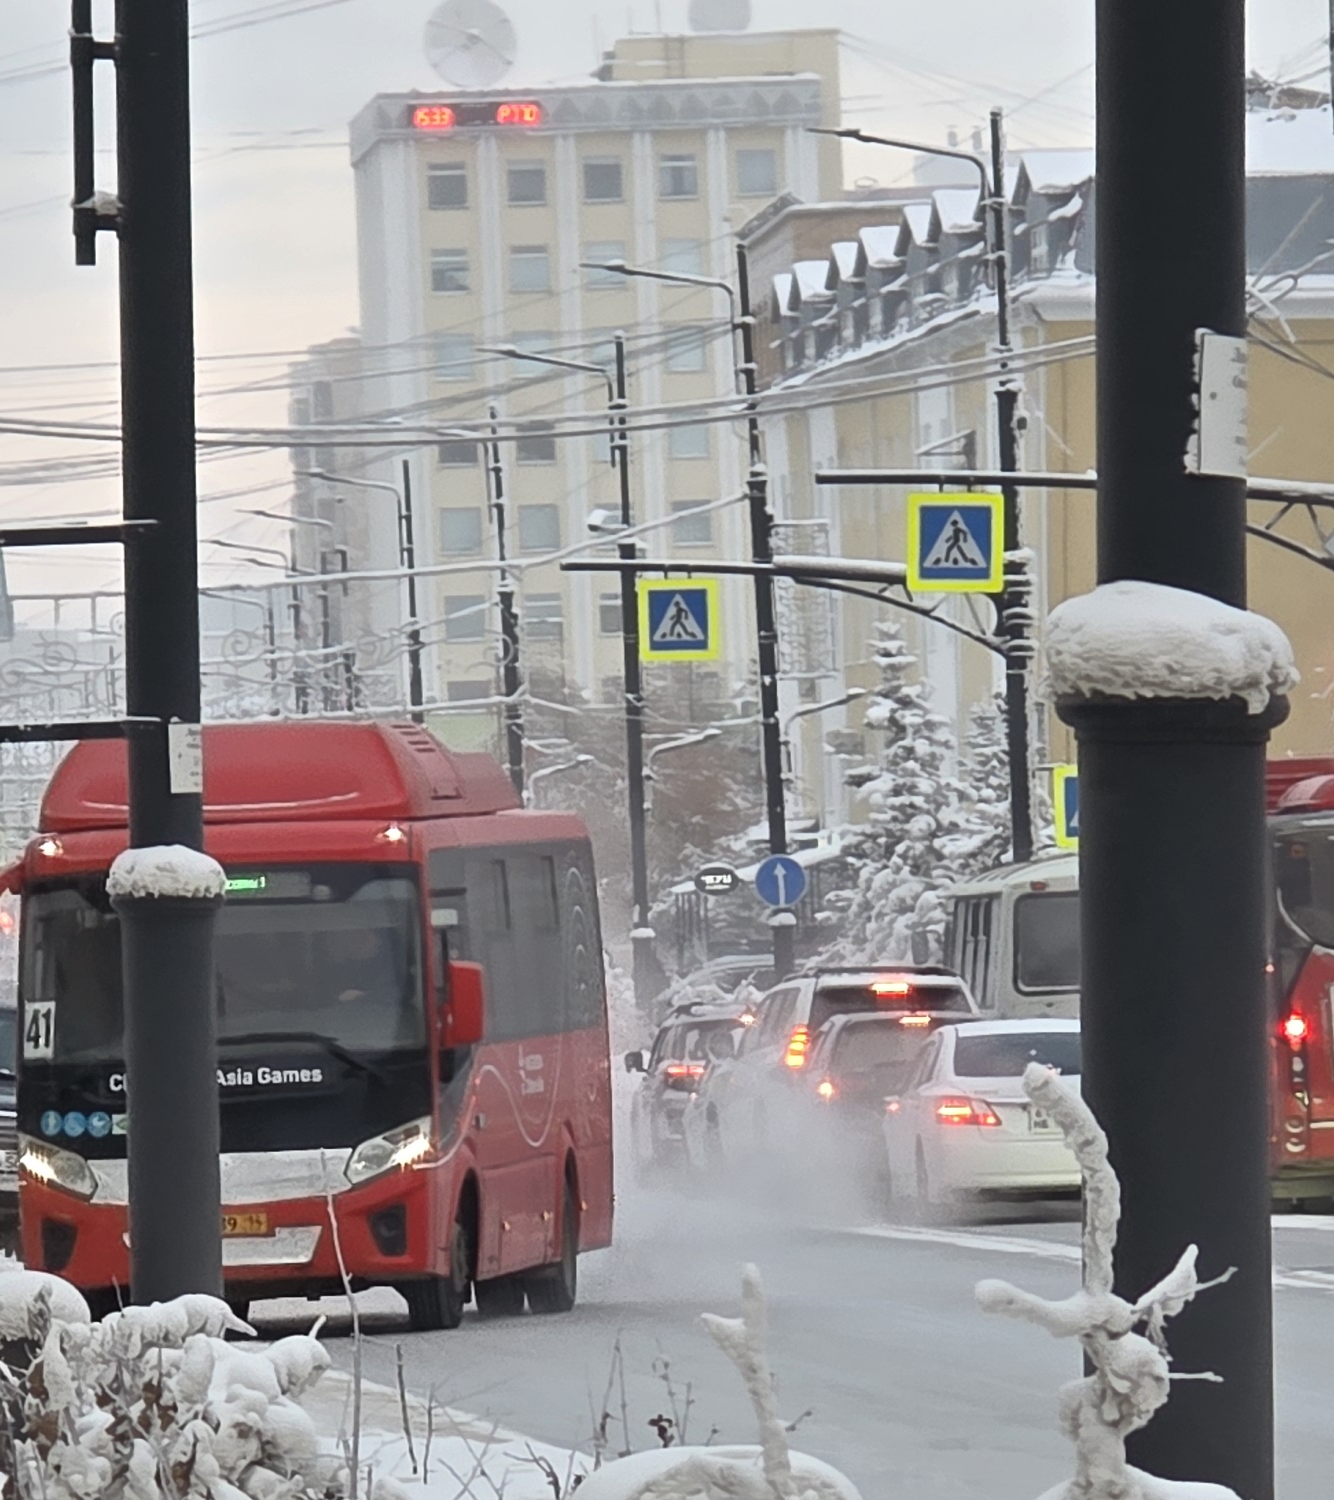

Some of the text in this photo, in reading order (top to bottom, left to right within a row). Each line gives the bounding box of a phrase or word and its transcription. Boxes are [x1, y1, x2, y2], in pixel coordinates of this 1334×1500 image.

[26, 1008, 52, 1050] 41
[216, 1067, 323, 1086] Asia Games
